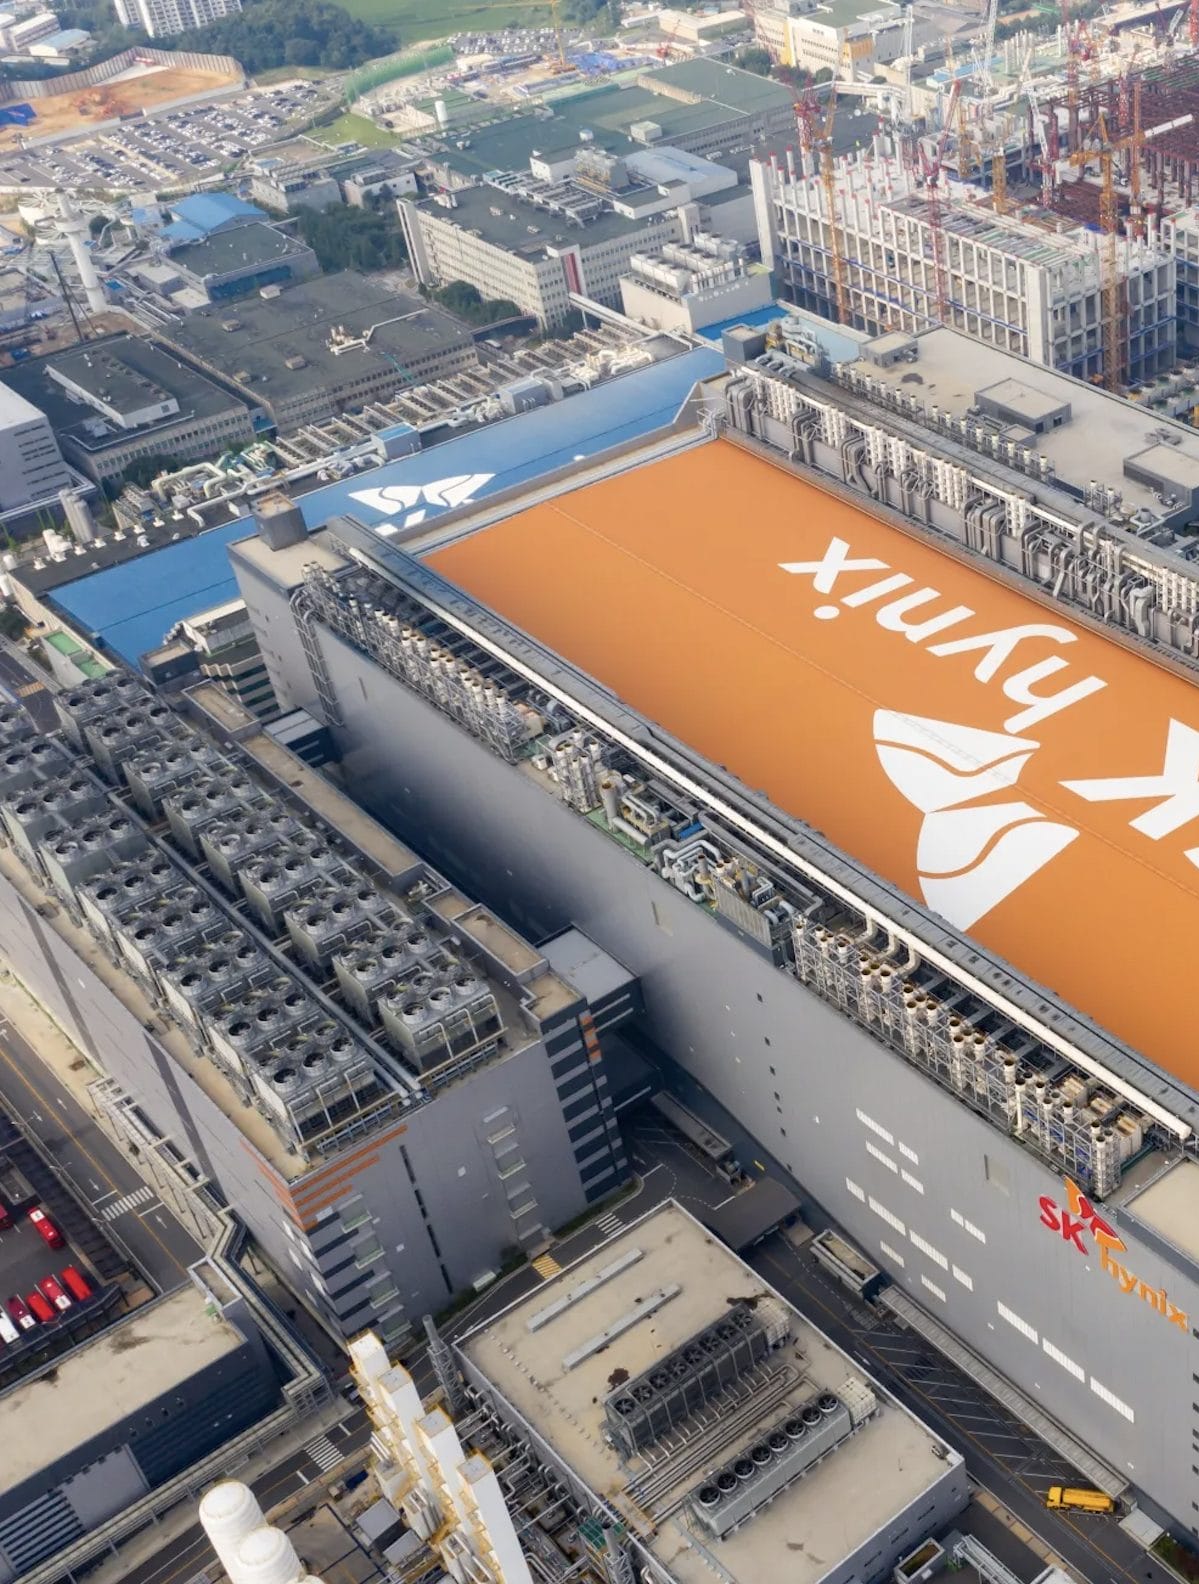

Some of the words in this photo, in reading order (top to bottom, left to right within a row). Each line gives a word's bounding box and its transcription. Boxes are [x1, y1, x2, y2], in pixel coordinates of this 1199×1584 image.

[777, 536, 1108, 734] hynix
[1039, 1195, 1089, 1256] SK
[1102, 1246, 1189, 1332] hynix
